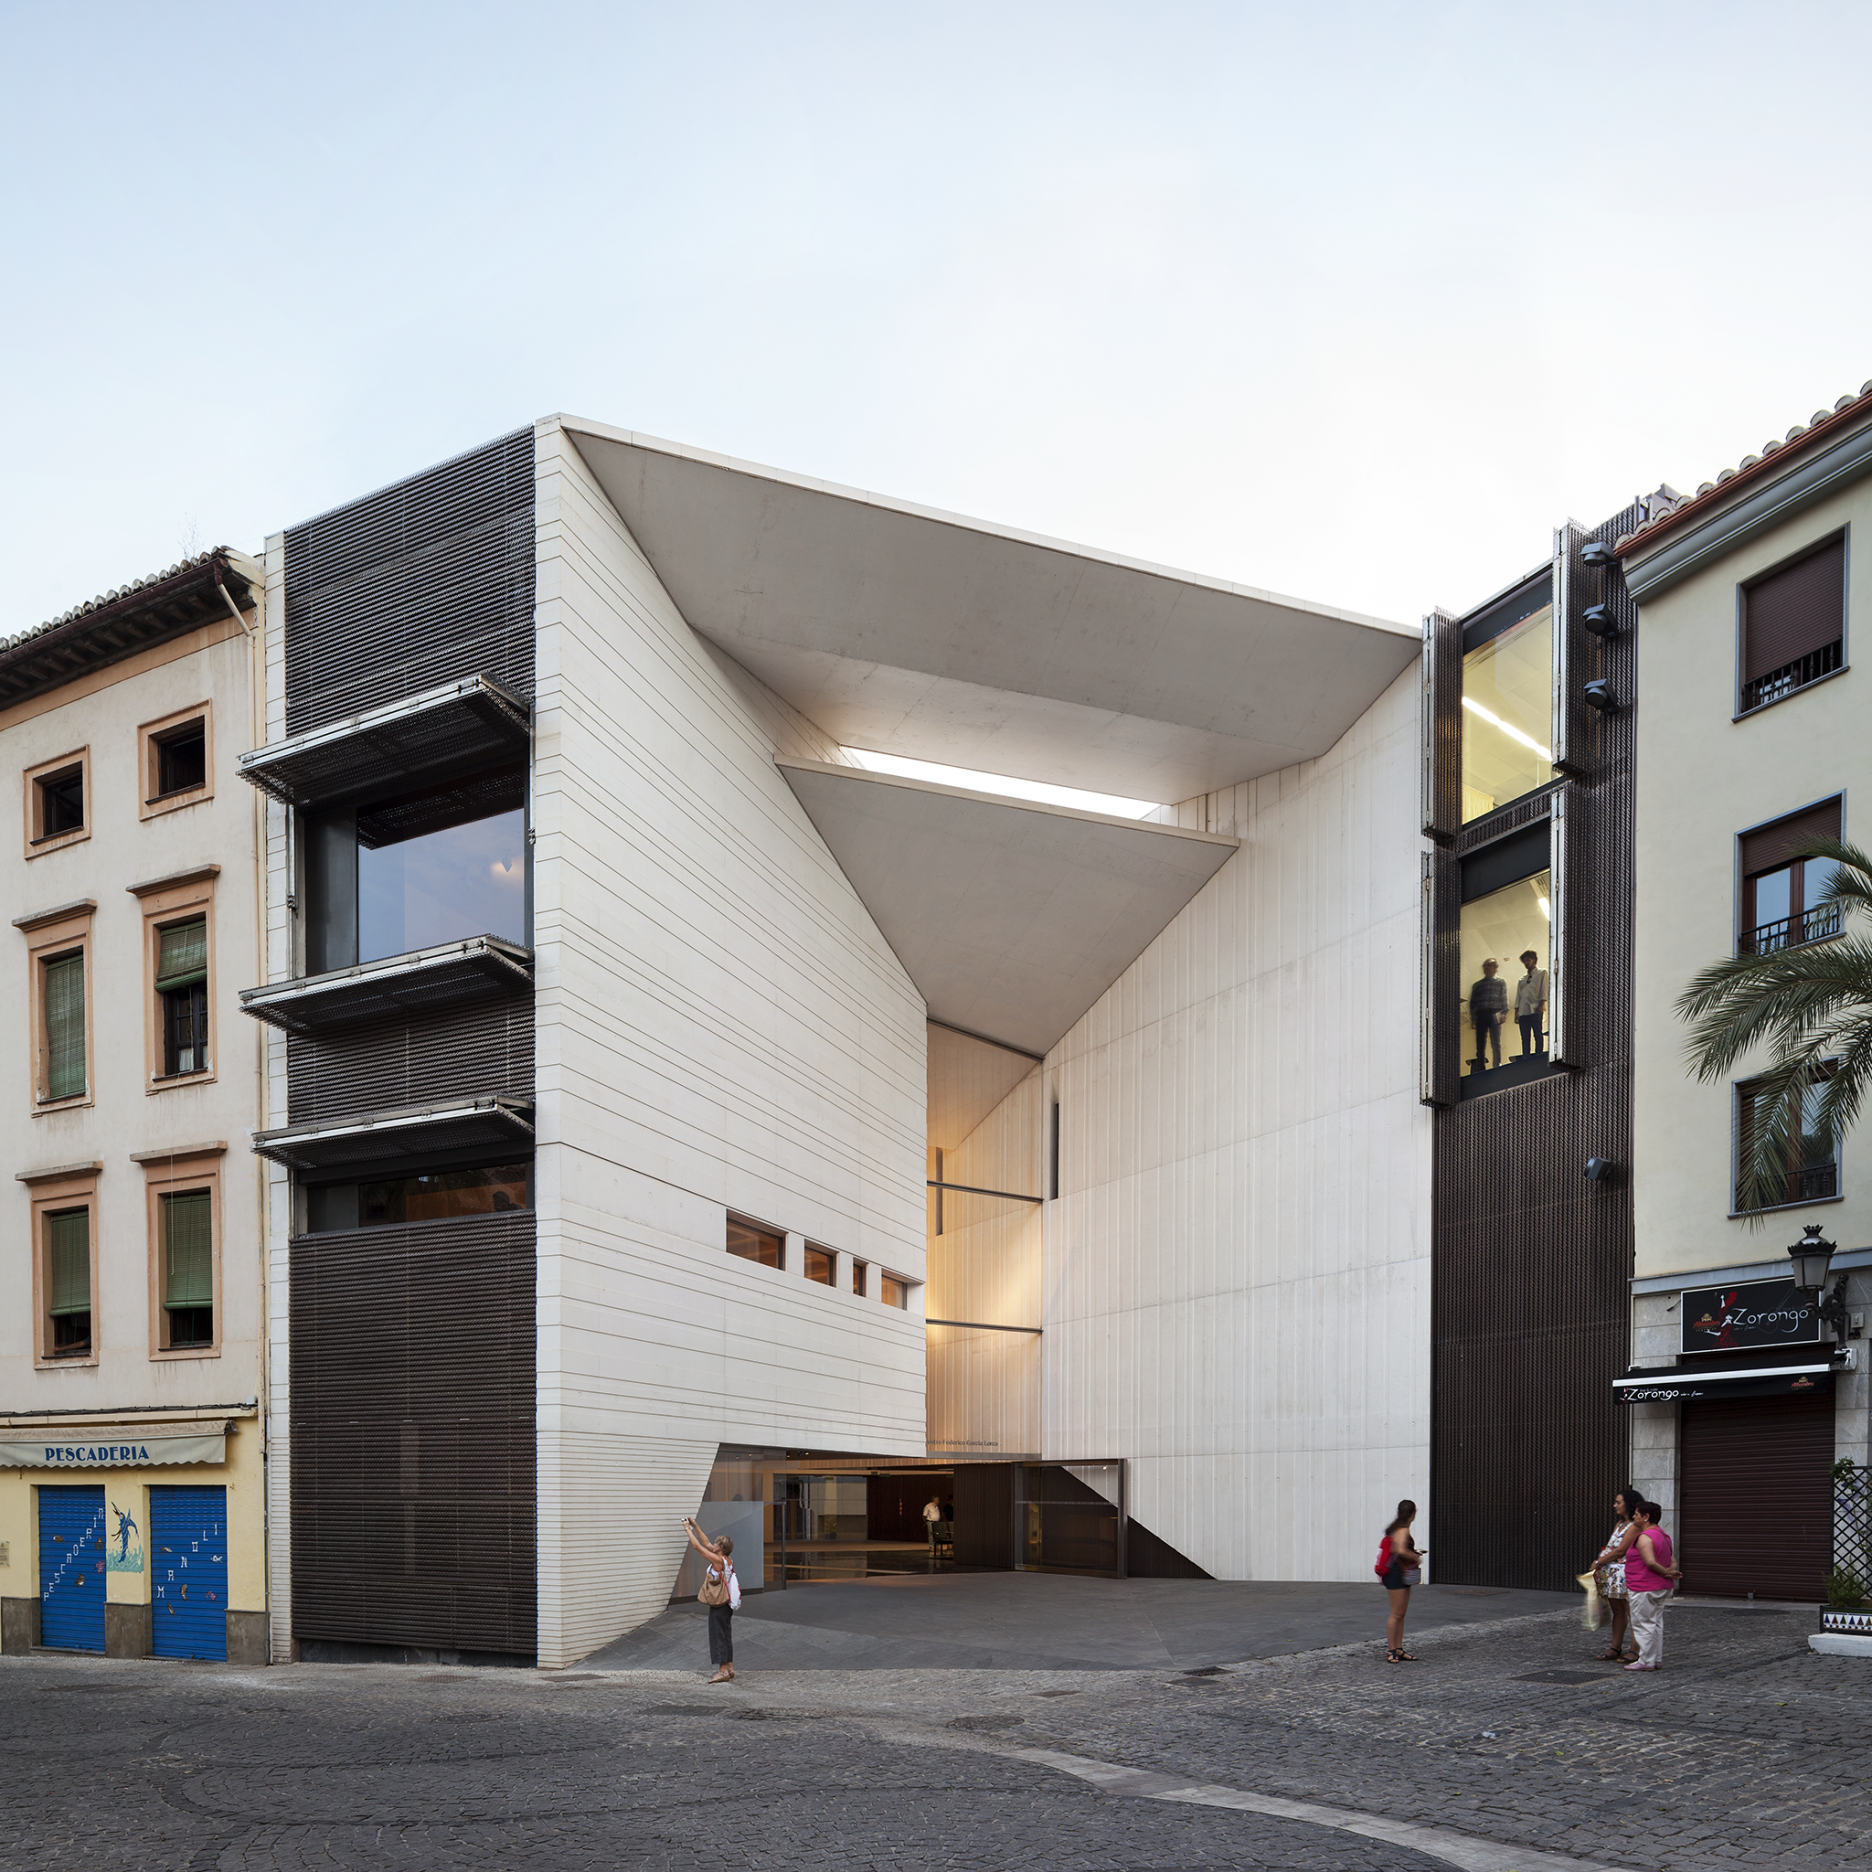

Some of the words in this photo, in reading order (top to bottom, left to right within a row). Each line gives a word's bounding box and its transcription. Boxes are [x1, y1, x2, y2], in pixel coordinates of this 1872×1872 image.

[1732, 1307, 1809, 1333] Zorongo
[1627, 1387, 1680, 1401] Zorongo
[45, 1446, 149, 1461] PESCADERIA
